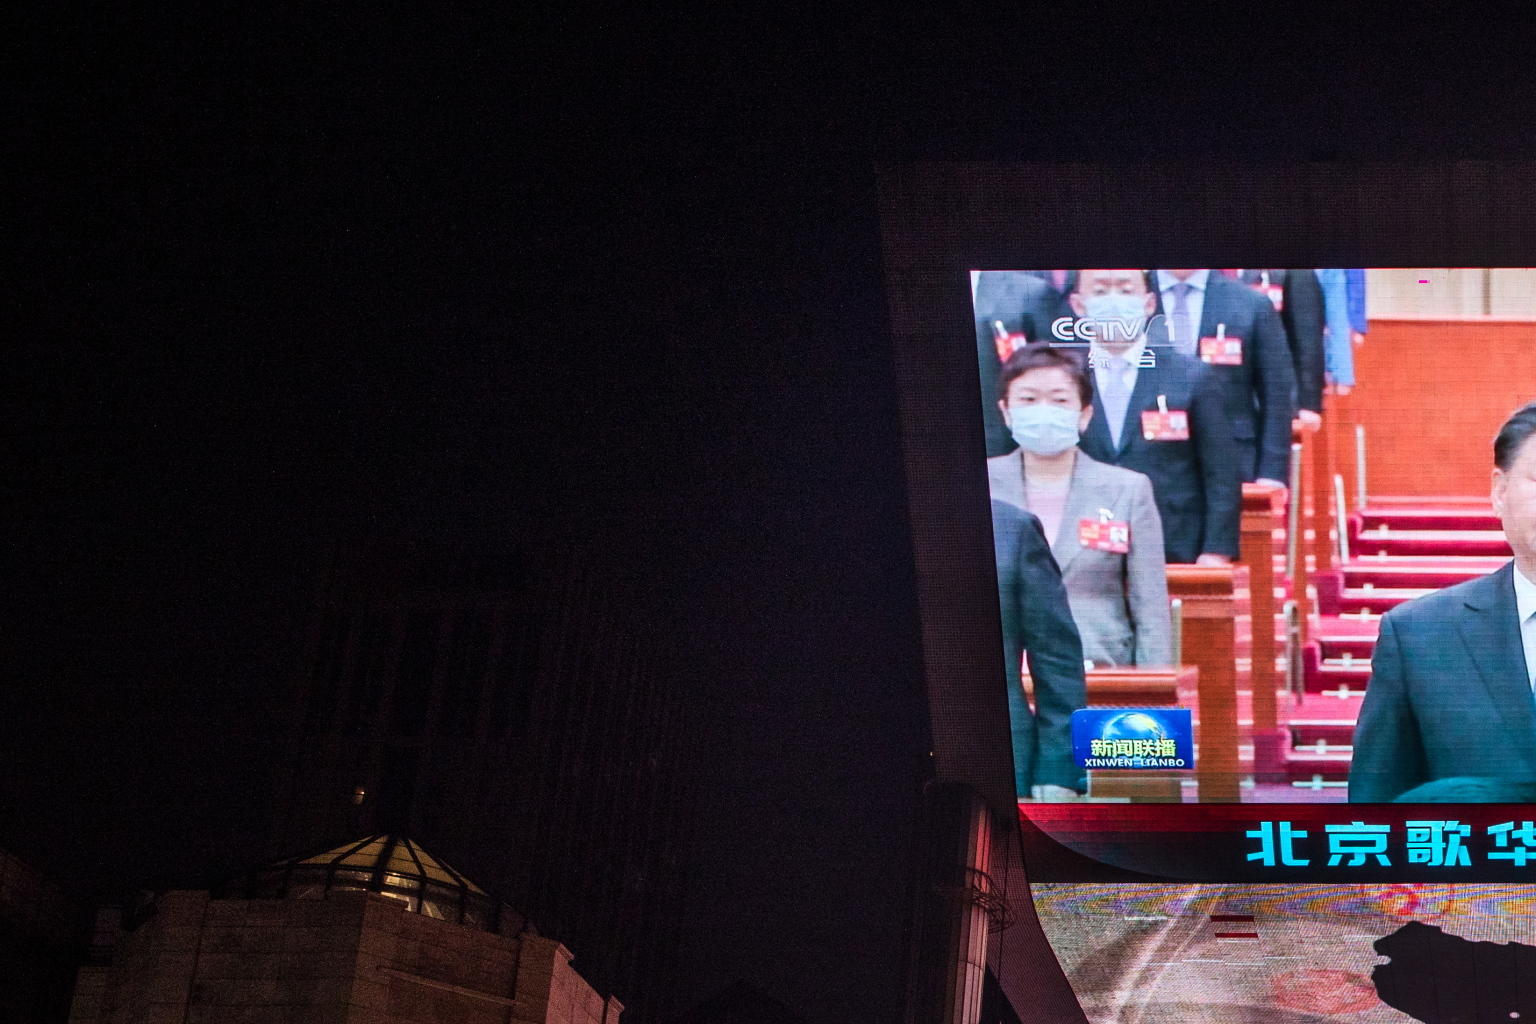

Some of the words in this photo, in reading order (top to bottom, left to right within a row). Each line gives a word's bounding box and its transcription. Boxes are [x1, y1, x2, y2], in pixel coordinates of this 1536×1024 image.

[1051, 317, 1143, 342] CCTV
[1090, 739, 1176, 757] 新闻联播
[1084, 758, 1132, 767] XINWEN
[1140, 758, 1185, 767] LIANBO
